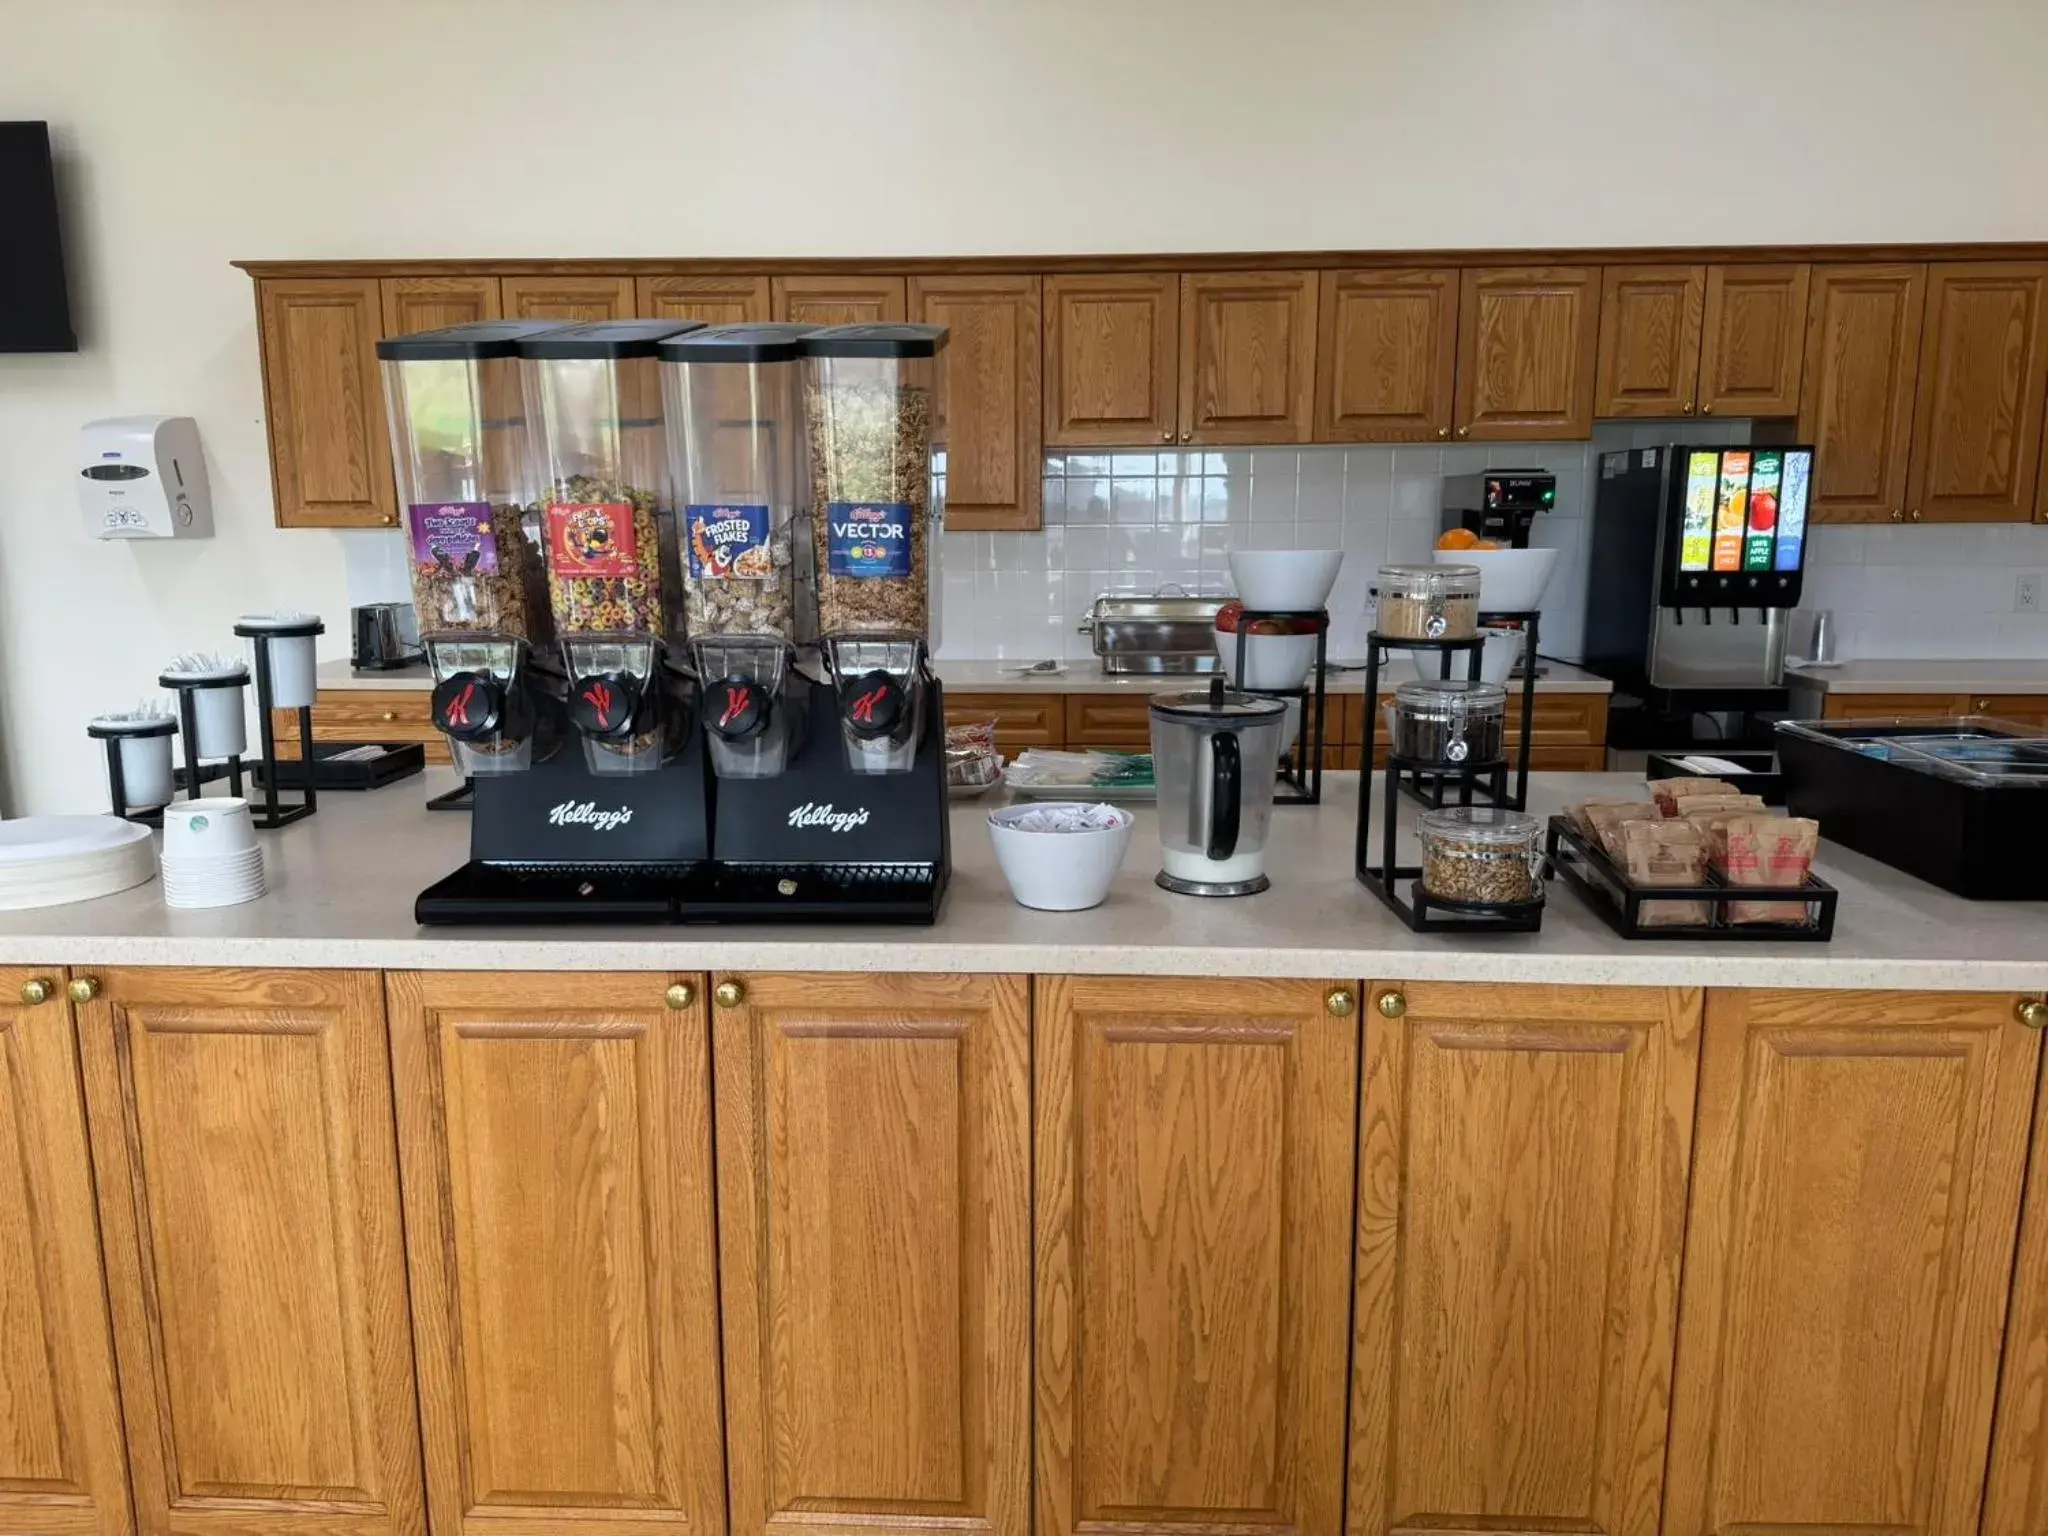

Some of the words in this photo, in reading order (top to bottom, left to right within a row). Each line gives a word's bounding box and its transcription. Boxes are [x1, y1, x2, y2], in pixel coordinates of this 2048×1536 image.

[705, 520, 750, 538] FROSTED
[833, 523, 904, 539] VECTOR
[714, 531, 749, 546] FLAKES
[549, 800, 633, 831] Kellogg's
[788, 802, 869, 832] Kellogg's
